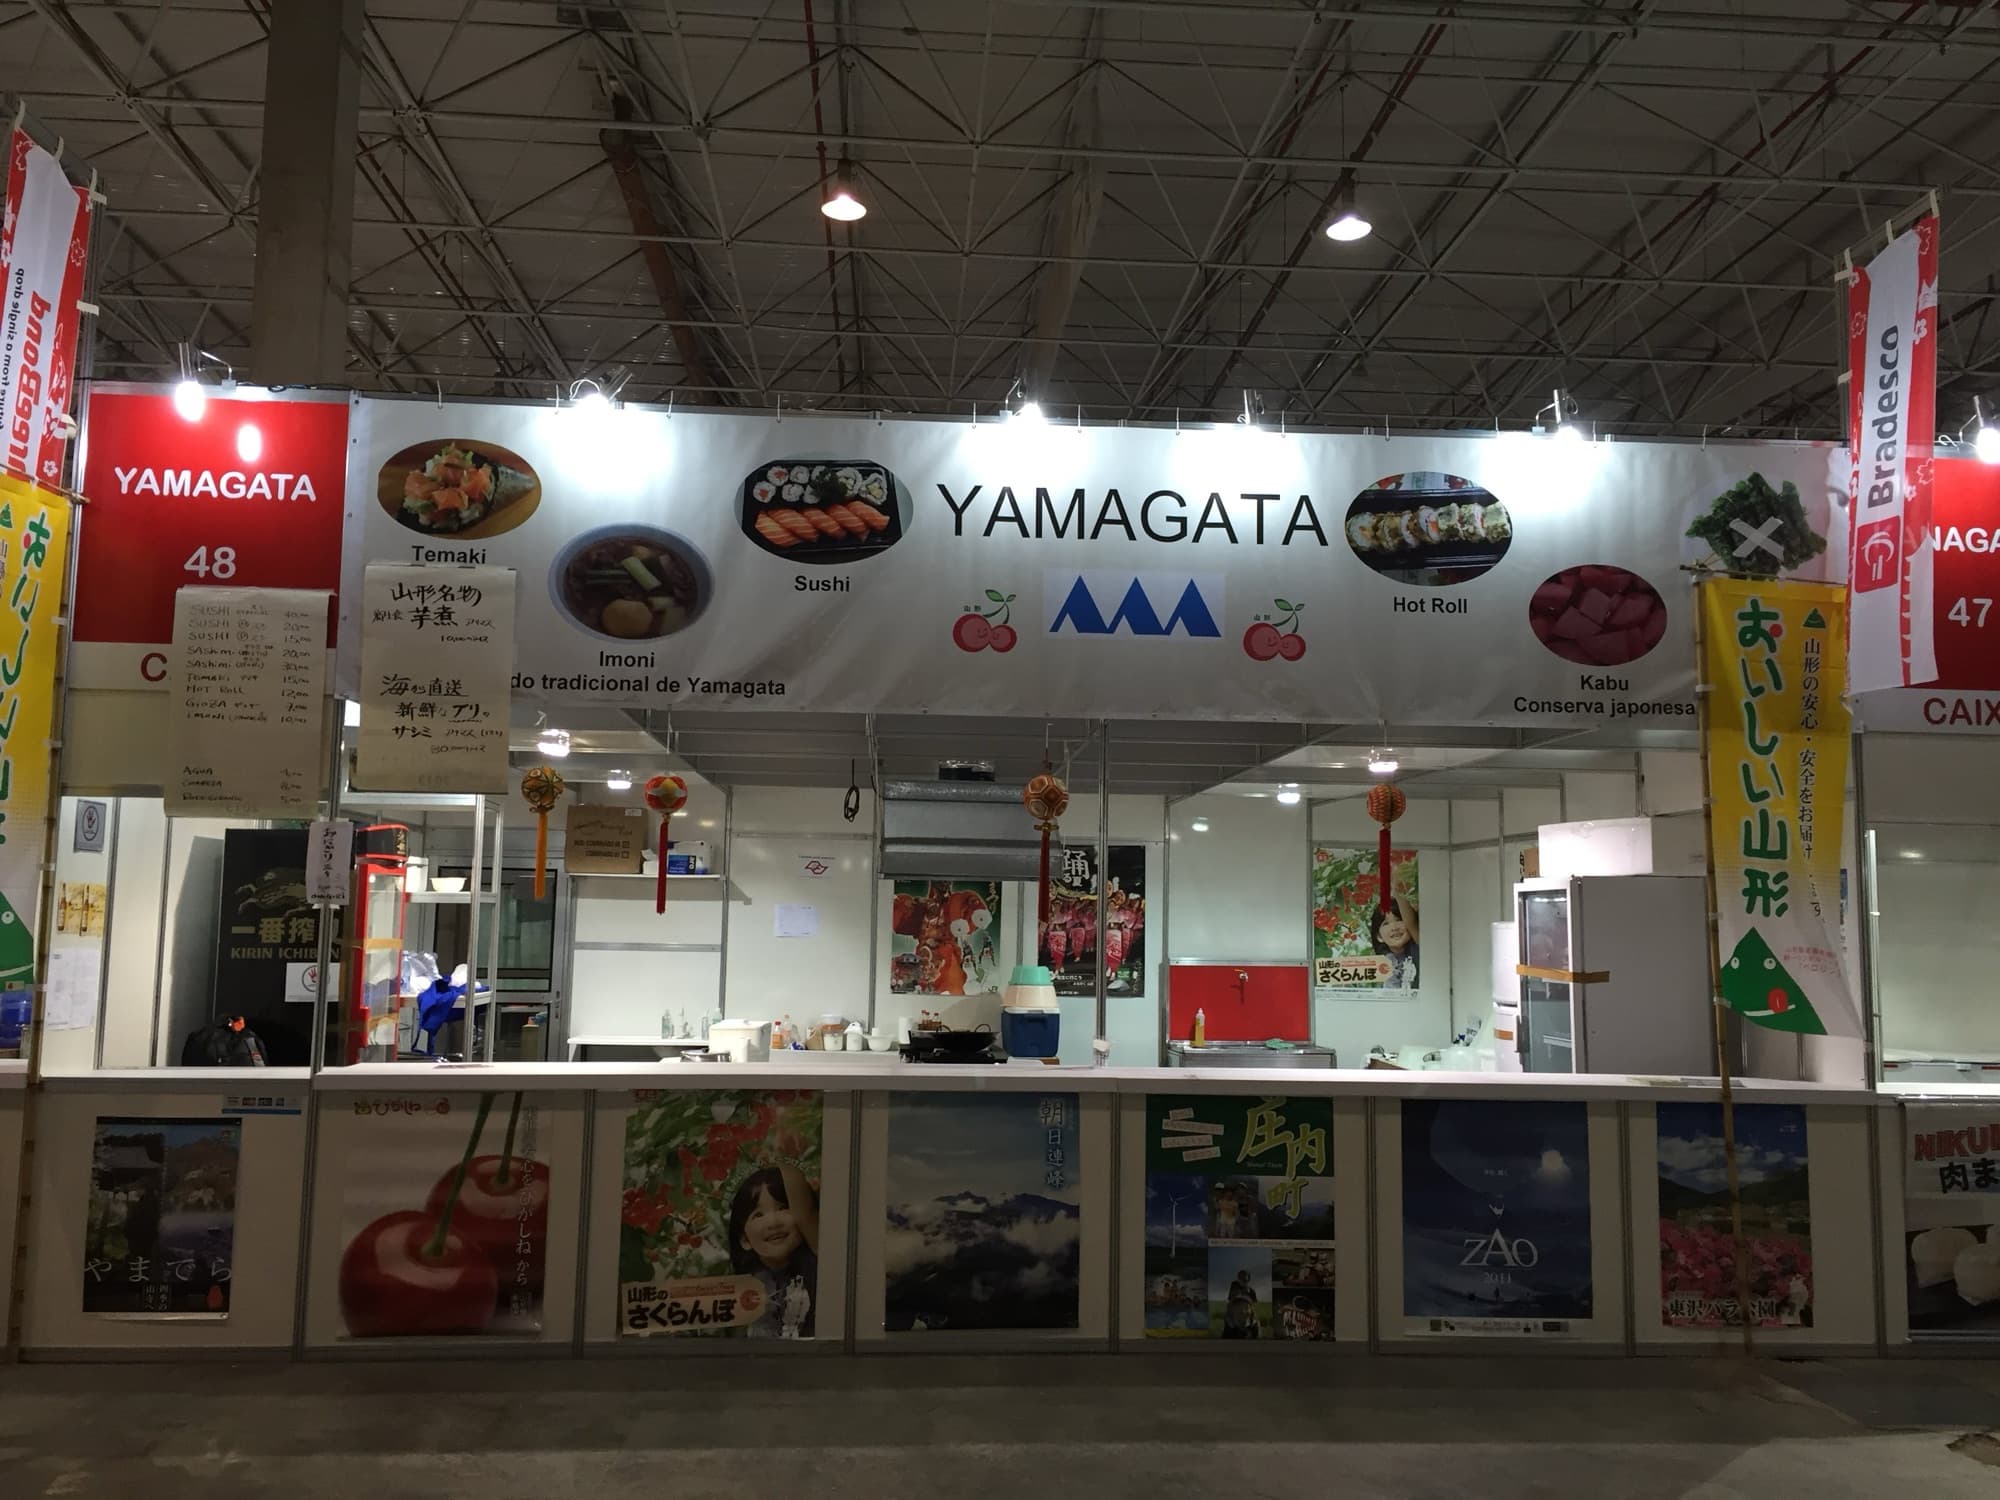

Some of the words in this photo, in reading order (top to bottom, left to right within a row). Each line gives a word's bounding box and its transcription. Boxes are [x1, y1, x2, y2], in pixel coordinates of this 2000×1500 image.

[1868, 324, 1899, 508] Bradesco
[114, 467, 316, 501] YAMAGATA
[936, 484, 1329, 546] YAMAGATA
[183, 545, 236, 578] 48
[411, 545, 486, 564] Temaki
[794, 575, 850, 593] Sushi
[391, 582, 482, 607] 山形名物
[191, 604, 230, 616] SUSHI
[1393, 597, 1426, 613] Hot
[1432, 598, 1468, 614] Roll
[1948, 597, 1993, 627] 47
[189, 618, 230, 629] SUSHI
[408, 606, 458, 629] 芋煮
[188, 631, 229, 641] SUSHI
[600, 651, 655, 668] Imoni
[511, 672, 536, 690] do
[540, 673, 649, 692] tradicional
[655, 675, 680, 694] de
[688, 677, 786, 700] Yamagata
[1581, 675, 1629, 691] Kabu
[1514, 697, 1604, 713] Conserva
[1610, 698, 1696, 717] japonesa
[392, 725, 432, 739] サシミ
[1737, 599, 1789, 918] おいしい山形
[231, 952, 273, 965] KIRIN
[278, 952, 340, 965] ICHIBN
[1319, 960, 1340, 969] 山形の
[1319, 968, 1377, 983] さくらんぼ
[1040, 1100, 1064, 1189] 朝日連峰
[1458, 1228, 1539, 1268] ZAO
[83, 1254, 232, 1283] やまでら
[627, 1286, 668, 1303] 山形の
[627, 1298, 737, 1330] さくらんぼ
